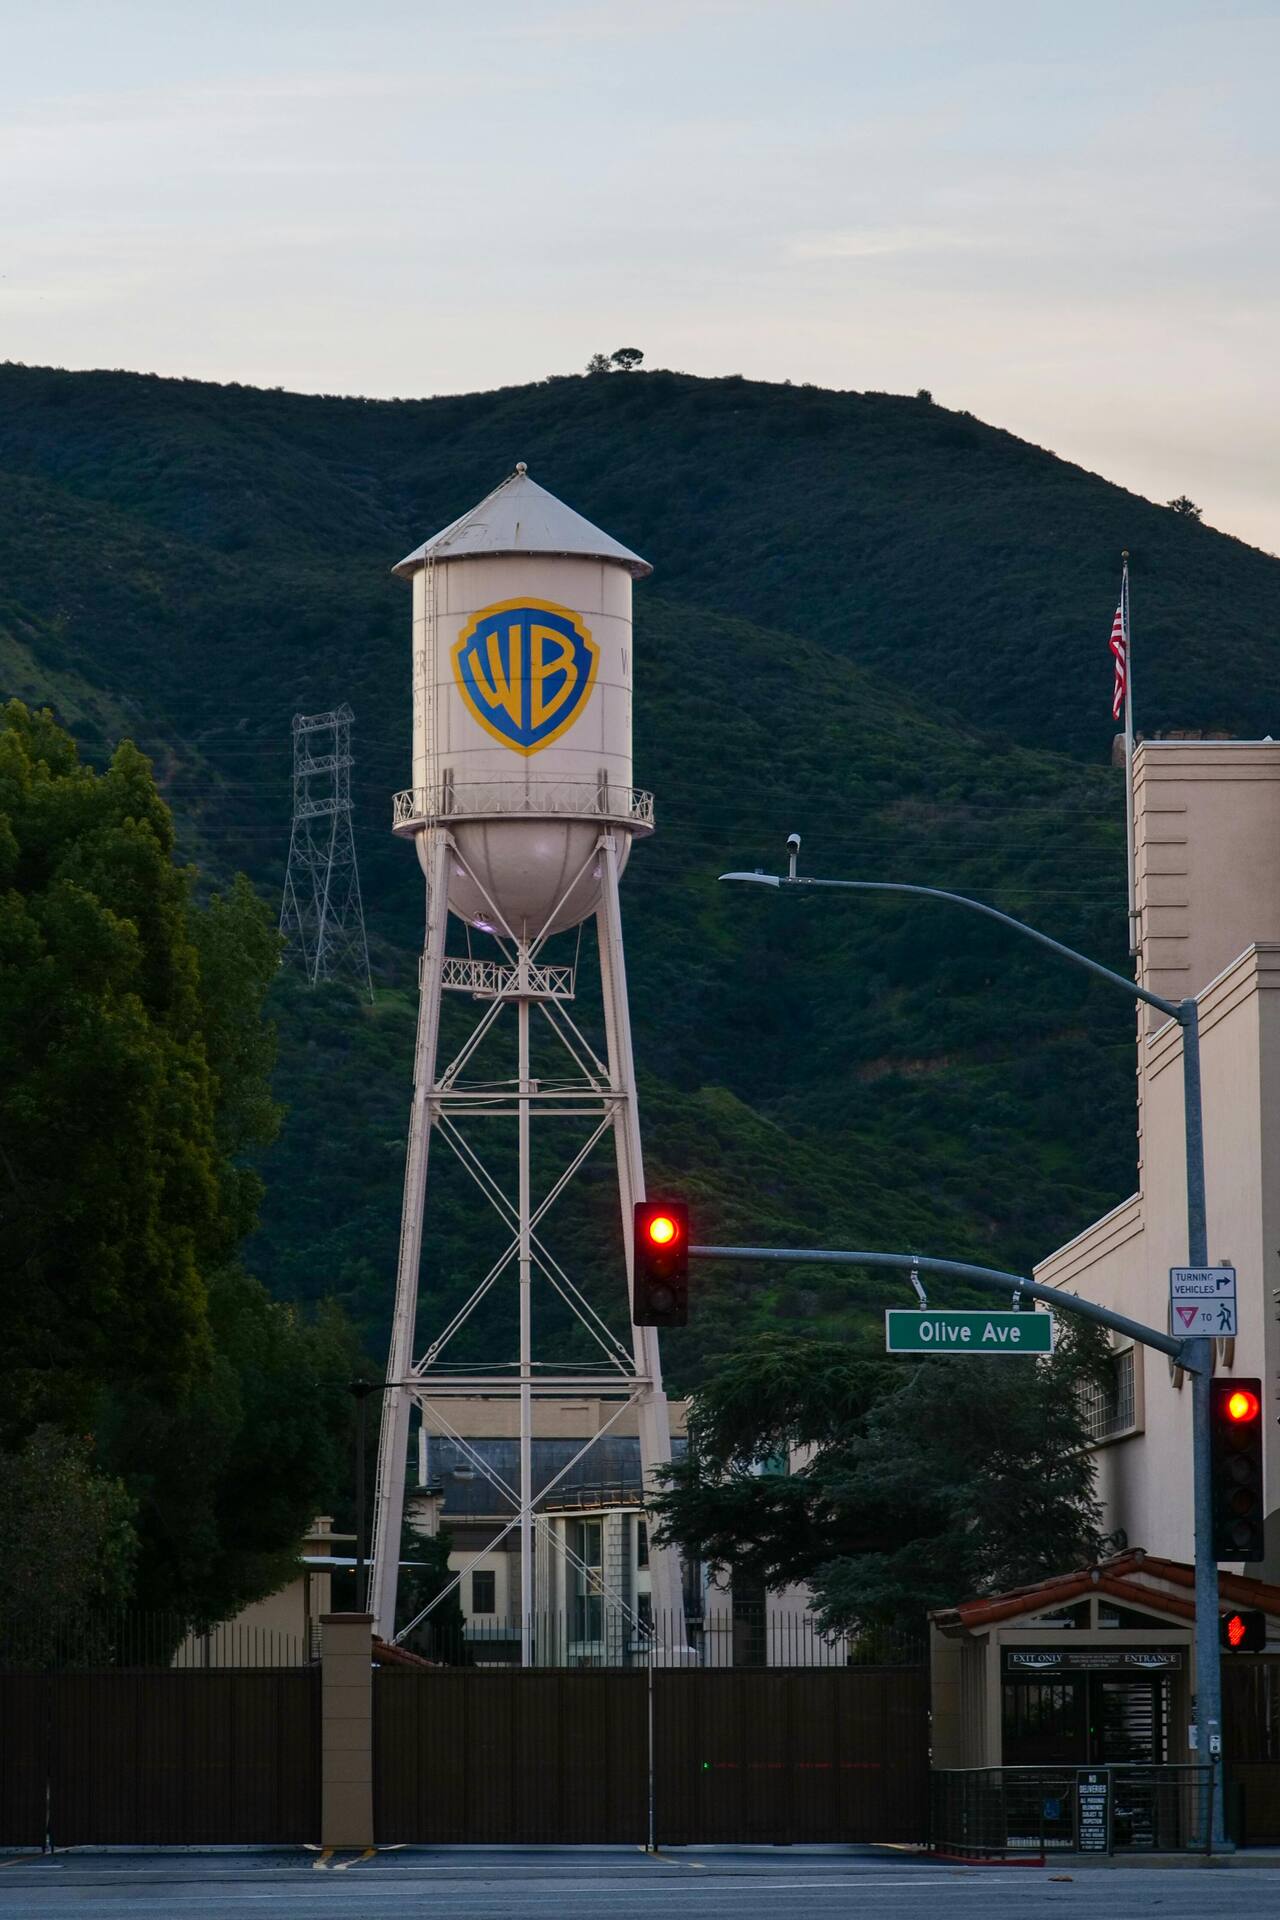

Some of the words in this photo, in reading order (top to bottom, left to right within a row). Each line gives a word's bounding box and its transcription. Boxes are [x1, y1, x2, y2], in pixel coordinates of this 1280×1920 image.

[468, 624, 578, 730] WB
[1176, 1273, 1213, 1281] TURNING
[1175, 1285, 1215, 1294] VEHICLES
[1201, 1313, 1212, 1321] TO
[919, 1321, 971, 1342] Olive
[982, 1322, 1021, 1343] Ave
[1013, 1654, 1035, 1663] EXIT
[1038, 1654, 1062, 1663] ONLY
[1124, 1654, 1177, 1663] ENTRANCE
